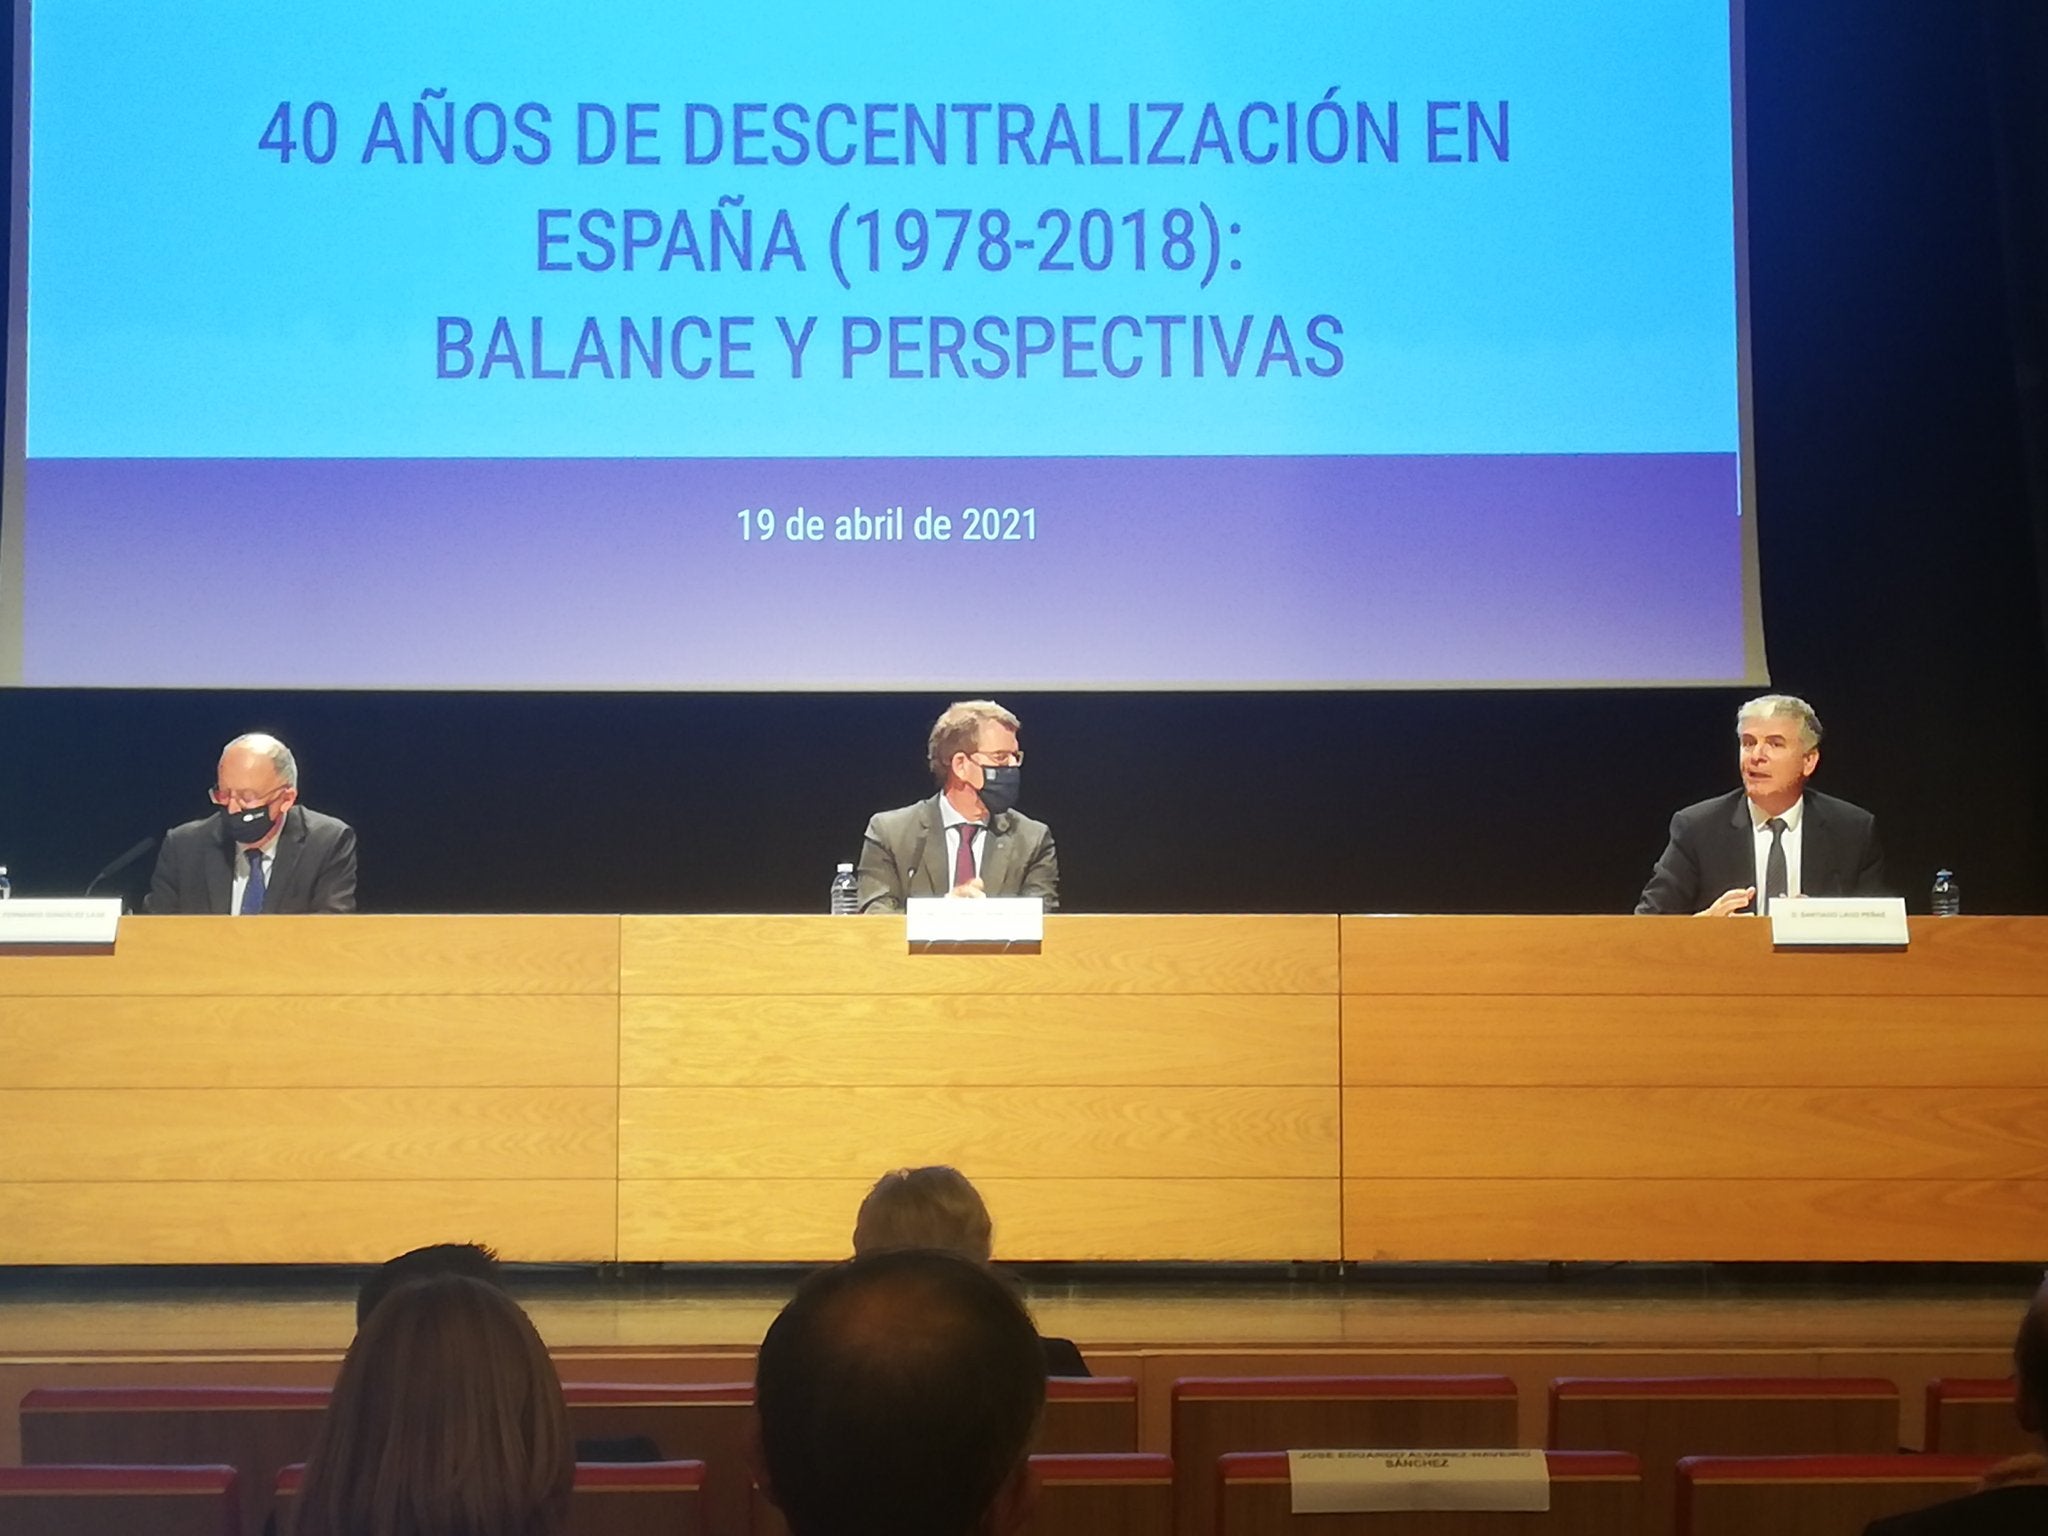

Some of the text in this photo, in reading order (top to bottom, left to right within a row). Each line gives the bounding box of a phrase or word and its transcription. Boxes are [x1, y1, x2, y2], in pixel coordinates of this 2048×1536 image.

[259, 86, 1510, 165] 40 AÑOS DE DESCENTRALIZACIÓN EN
[537, 194, 1242, 289] ESPAÑA (1978-2018):
[437, 315, 1344, 379] BALANCE Y PERSPECTIVAS
[737, 506, 1035, 541] 19 de abril de 2021
